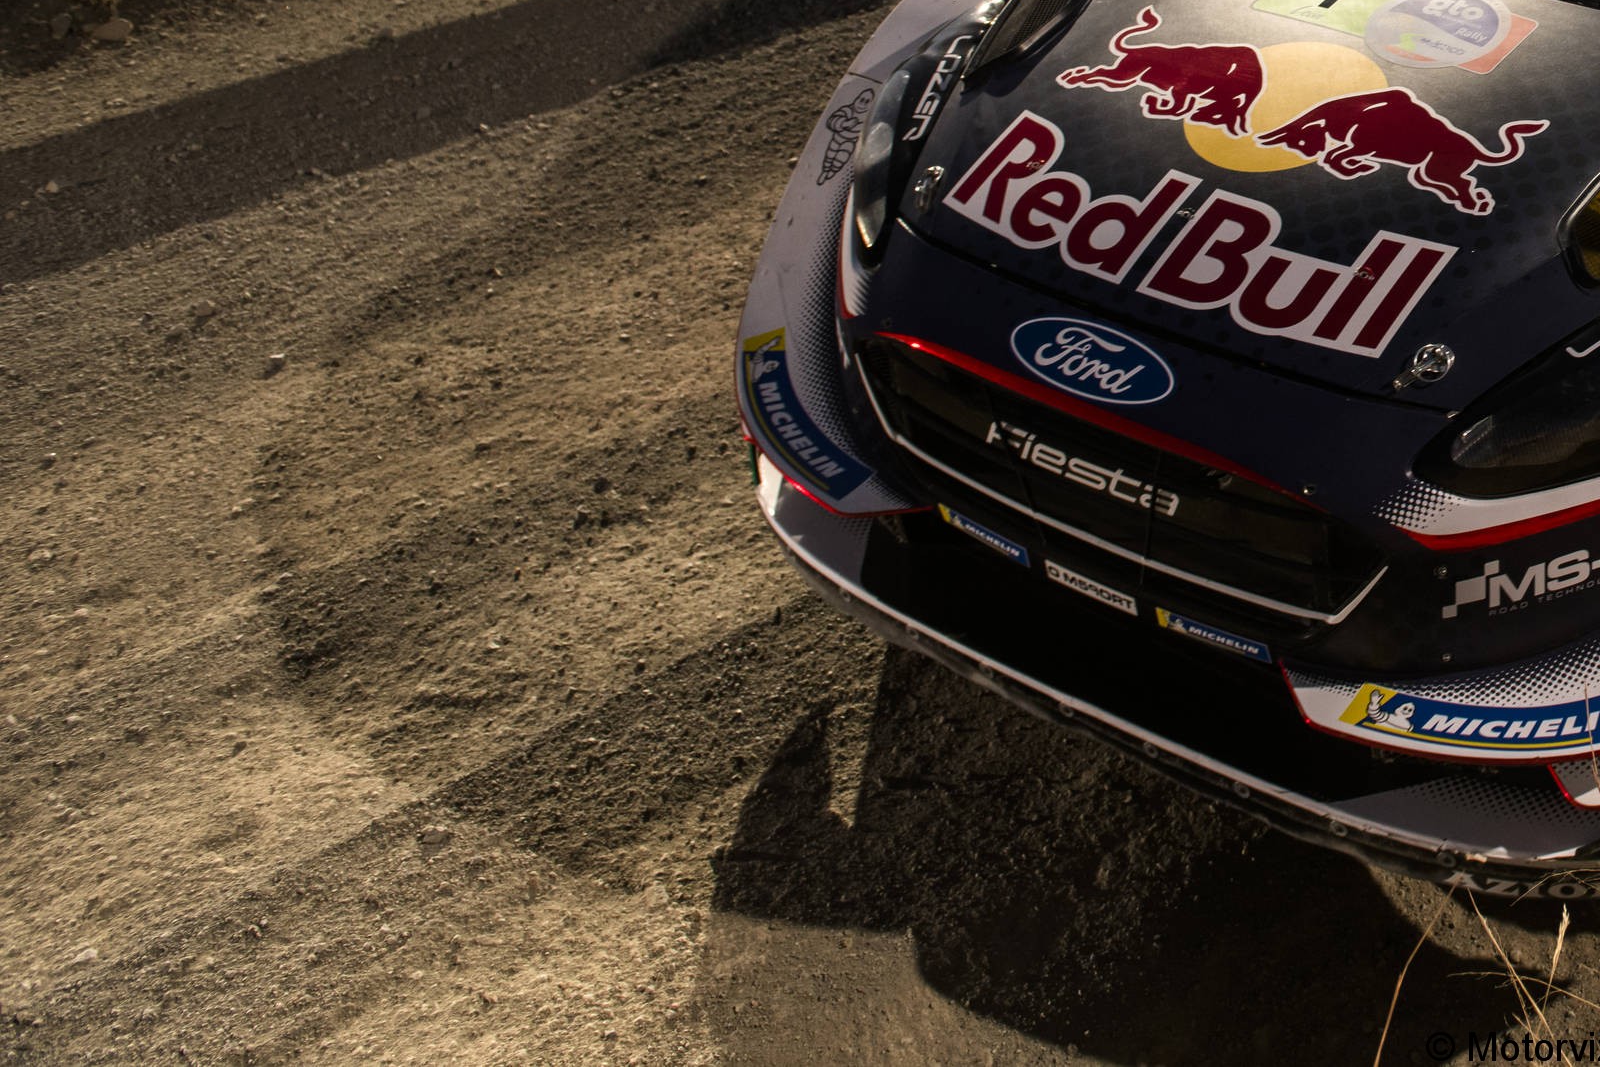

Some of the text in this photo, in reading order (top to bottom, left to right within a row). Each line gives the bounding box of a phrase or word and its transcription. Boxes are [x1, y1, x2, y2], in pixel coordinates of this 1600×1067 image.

[948, 114, 1454, 354] Red Bull
[1034, 326, 1146, 394] Ford
[757, 380, 846, 480] MICHELIN
[985, 421, 1180, 517] Fiesta
[964, 521, 1021, 558] MICHELIN
[1188, 624, 1260, 656] MICHELIN
[1488, 600, 1529, 617] ROAD
